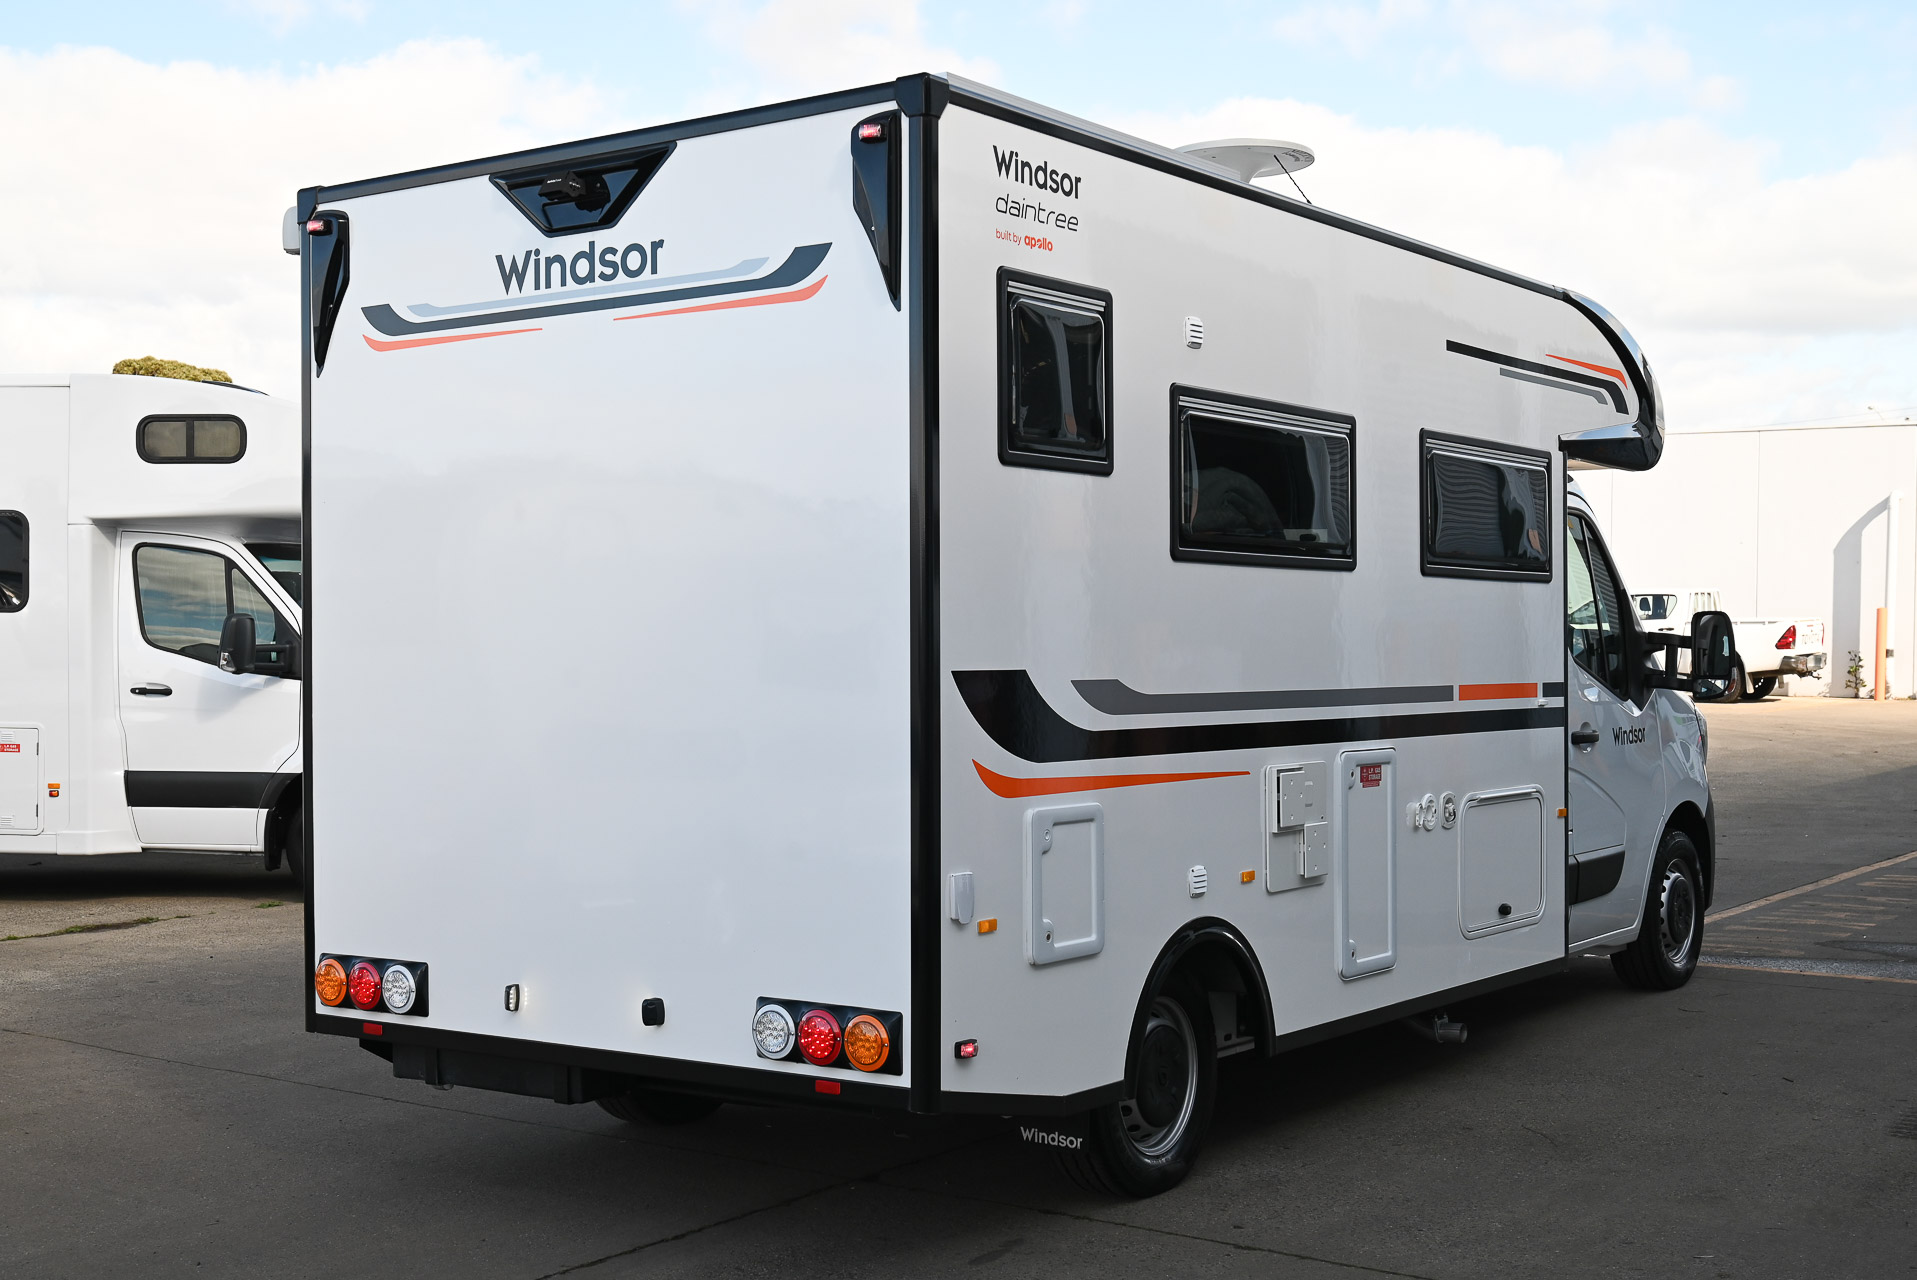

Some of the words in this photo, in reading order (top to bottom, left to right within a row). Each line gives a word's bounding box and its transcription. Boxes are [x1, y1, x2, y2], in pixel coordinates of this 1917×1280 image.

[993, 144, 1082, 200] Windsor
[995, 193, 1079, 232] daintree
[996, 228, 1012, 241] built
[1013, 232, 1022, 246] by
[1024, 235, 1054, 252] apollo
[495, 237, 665, 296] Windsor
[1612, 725, 1646, 746] Windsor
[1020, 1126, 1083, 1150] Windsor
